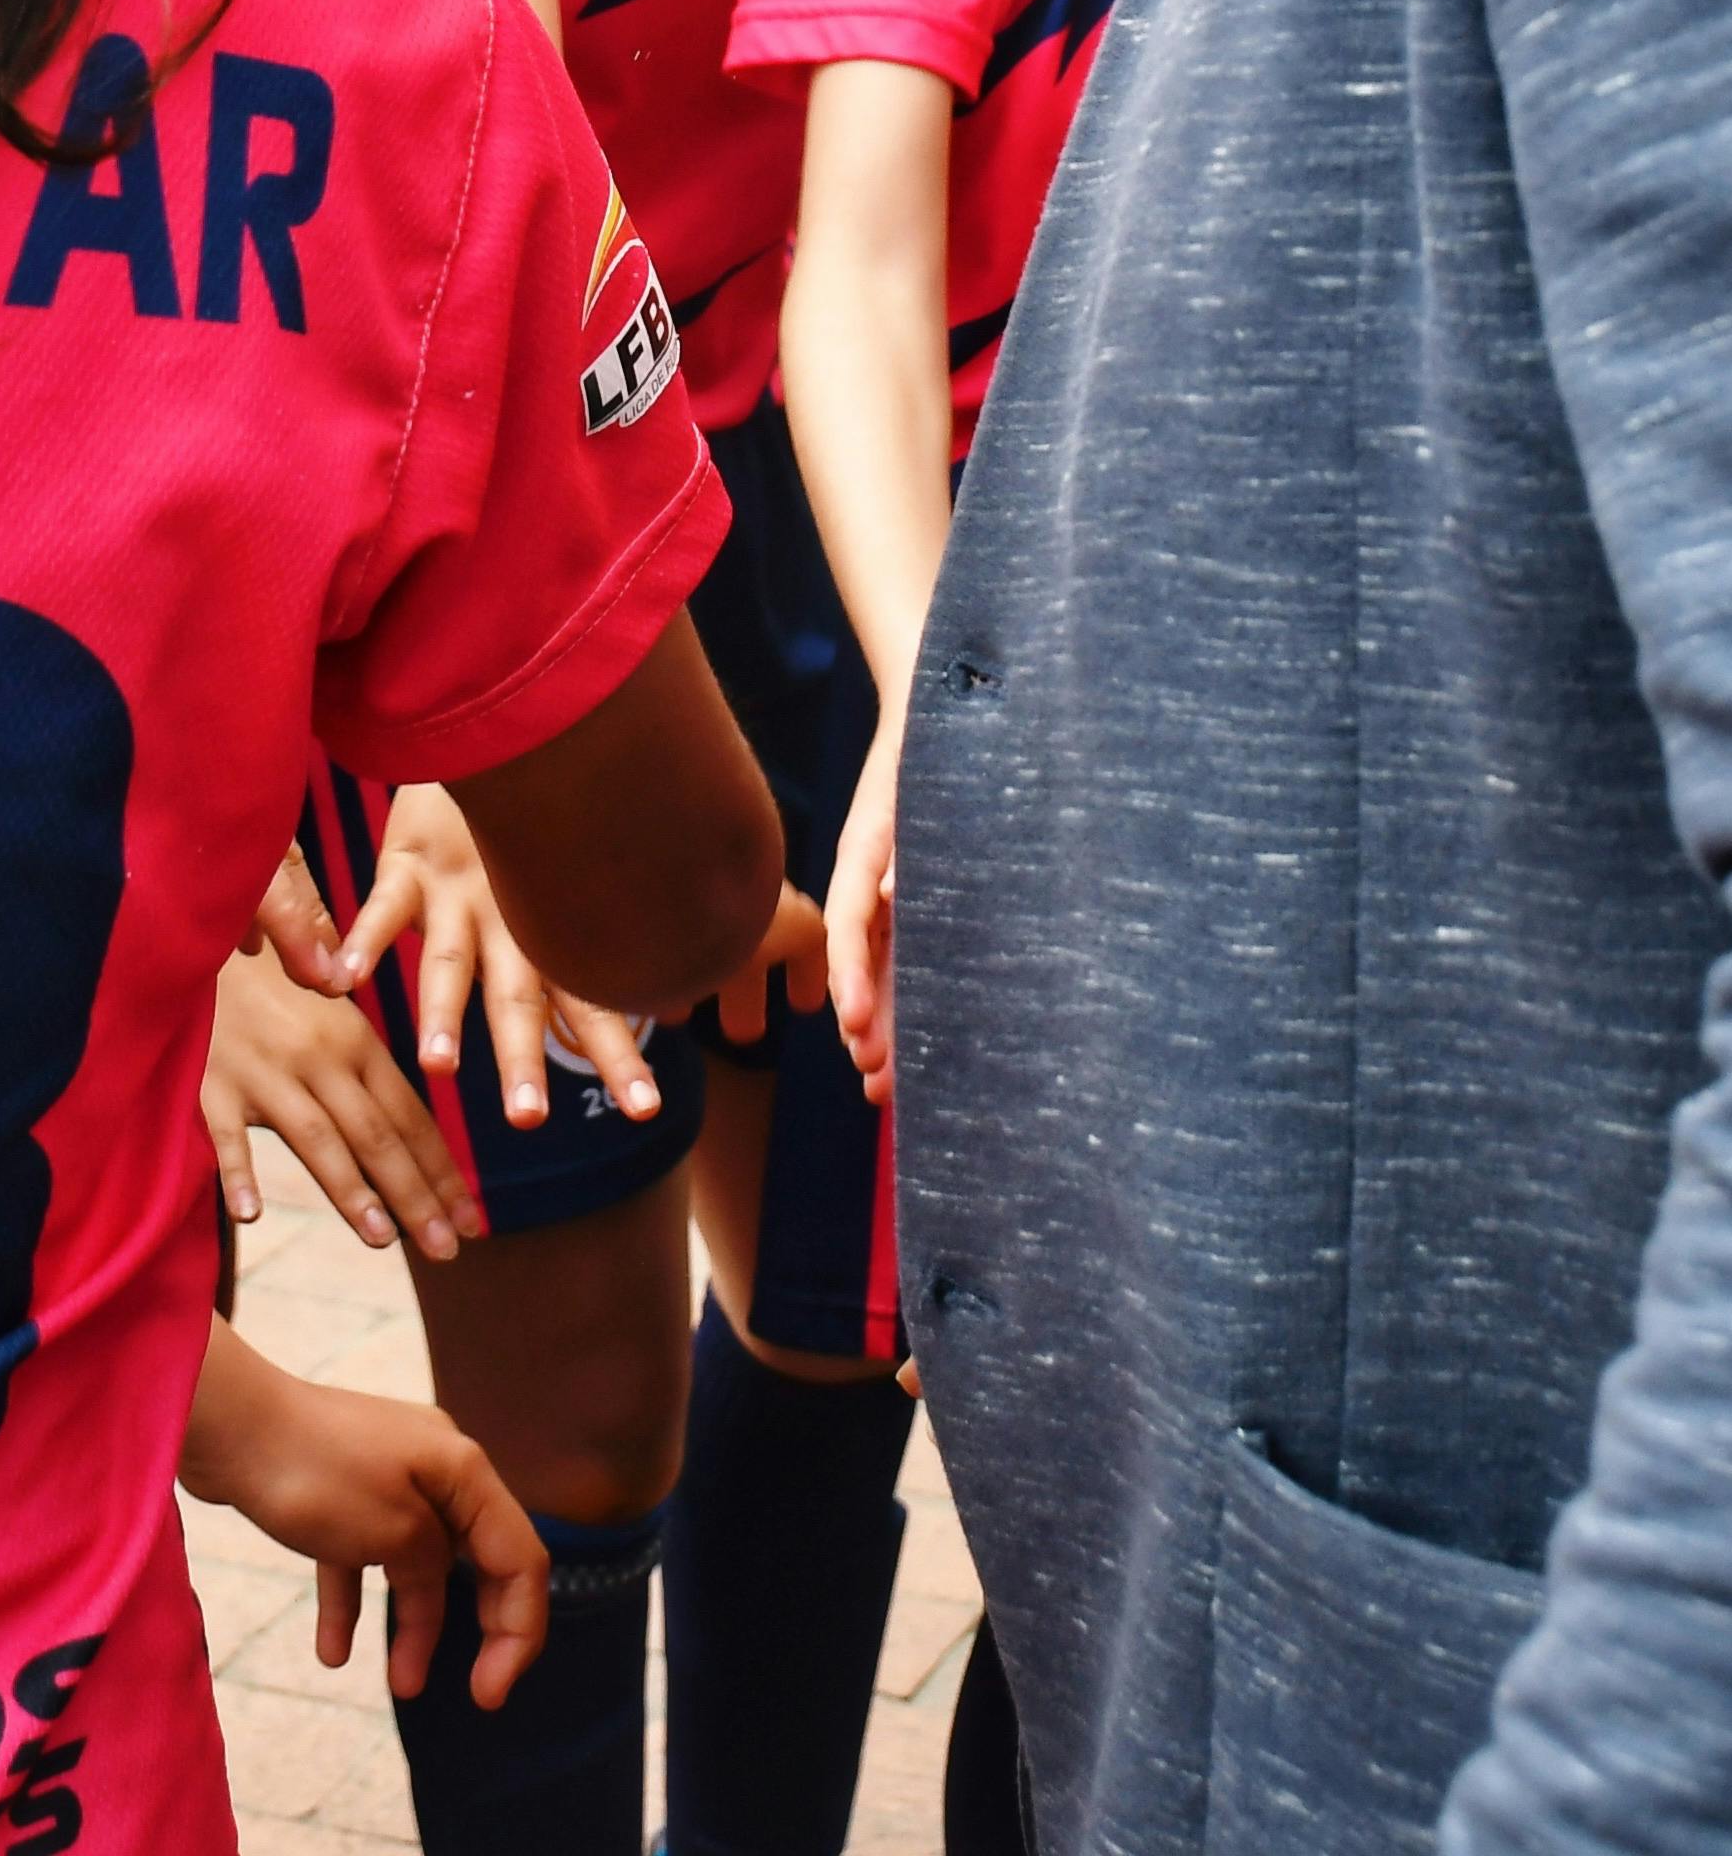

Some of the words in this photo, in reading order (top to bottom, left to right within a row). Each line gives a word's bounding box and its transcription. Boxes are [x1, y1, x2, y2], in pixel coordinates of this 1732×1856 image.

[583, 286, 668, 431] LFB
[624, 391, 653, 423] LIGA
[652, 369, 665, 394] DE
